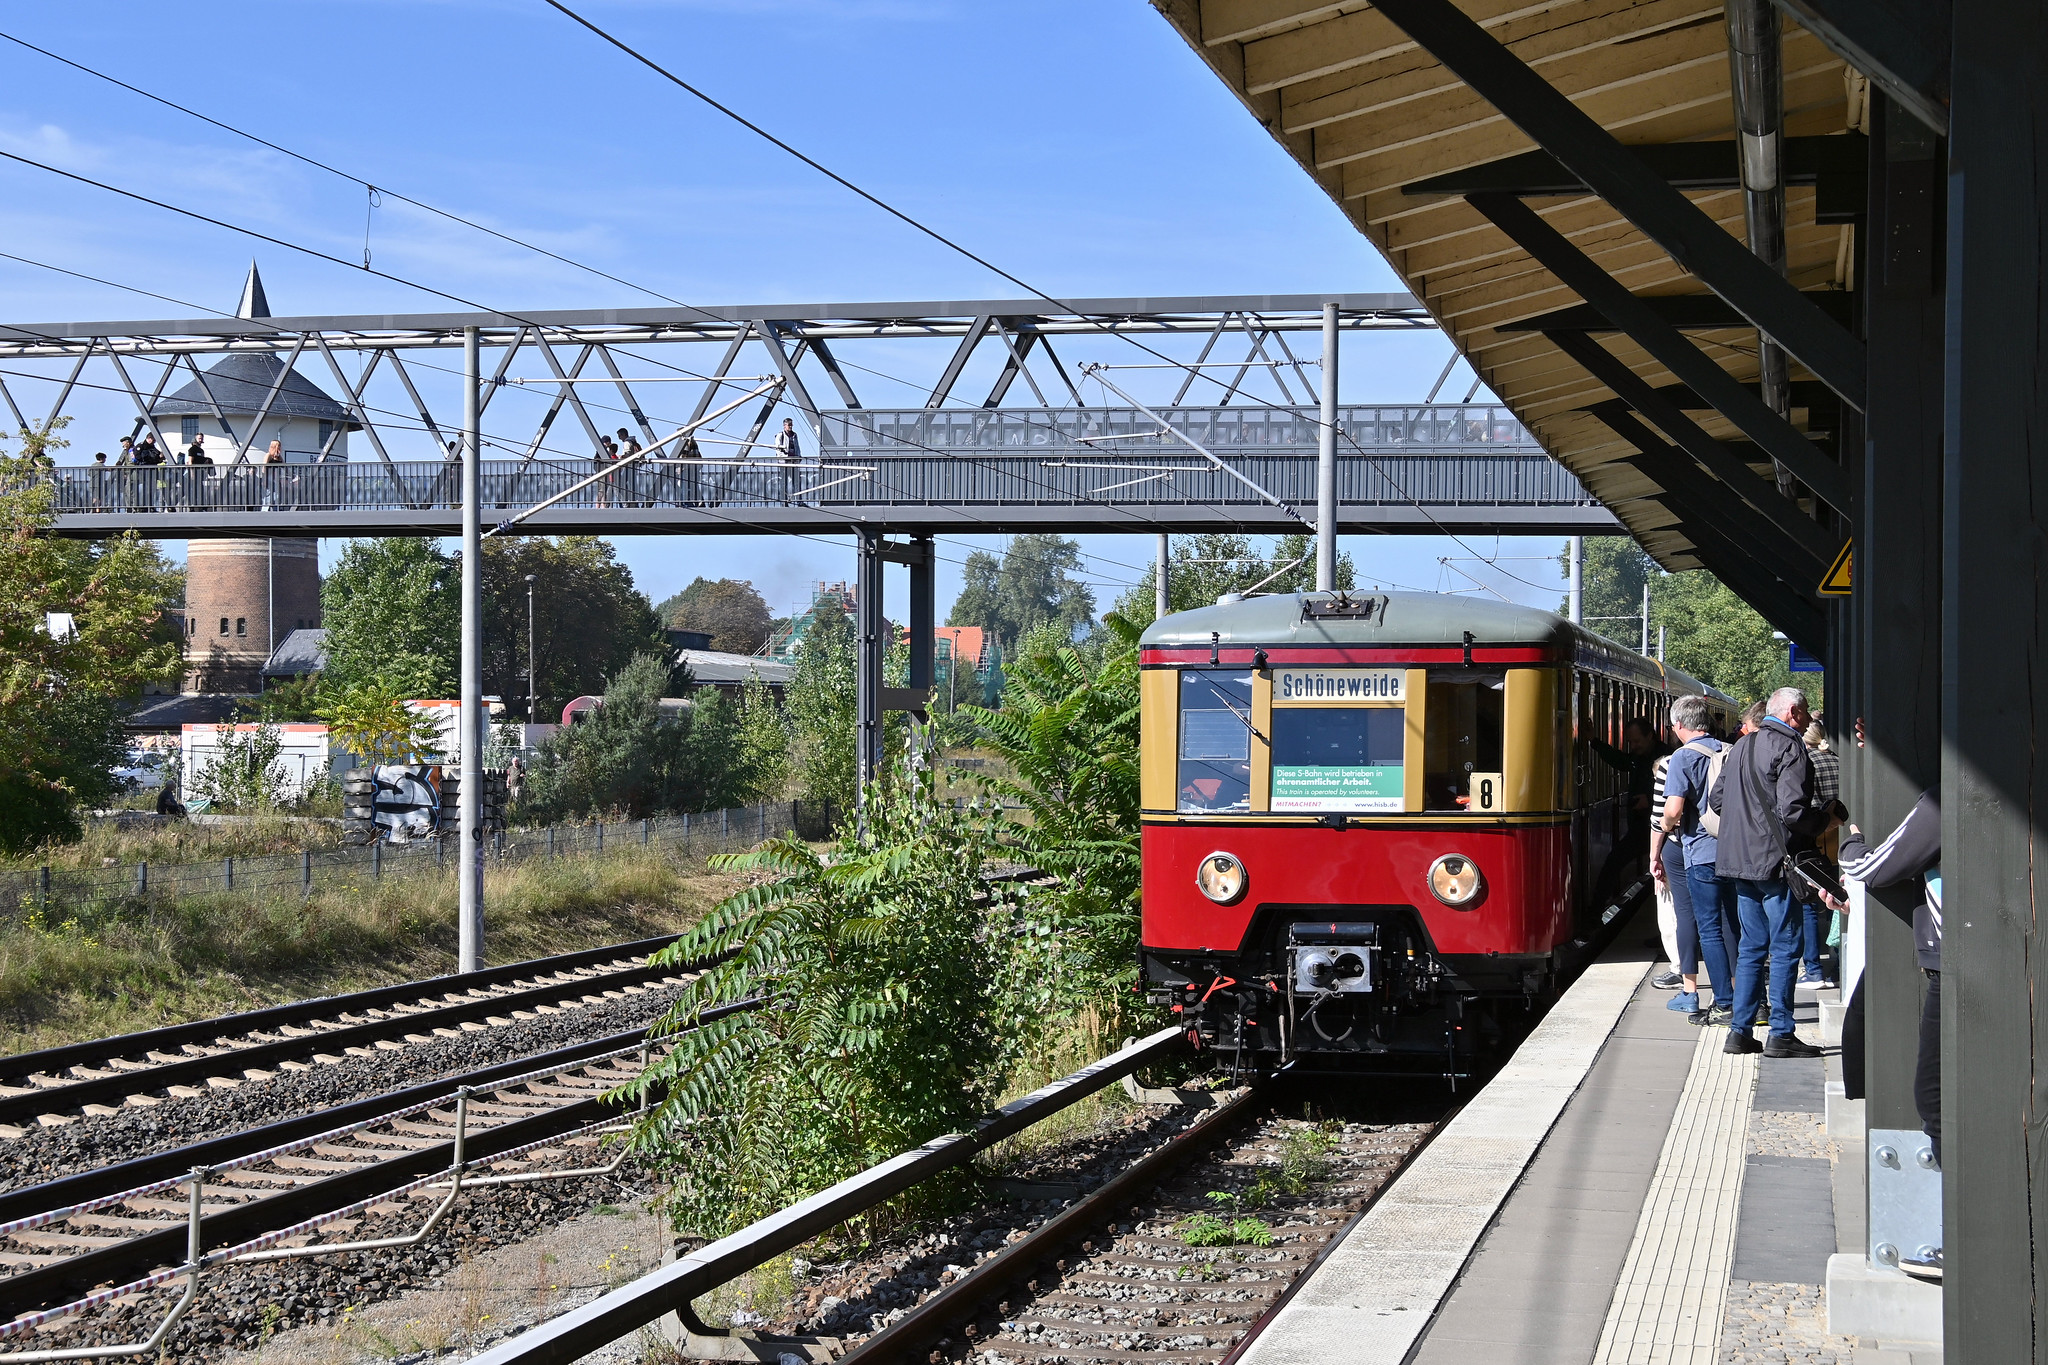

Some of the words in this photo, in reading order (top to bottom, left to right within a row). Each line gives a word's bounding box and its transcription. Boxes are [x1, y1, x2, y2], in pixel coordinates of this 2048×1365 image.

[1283, 673, 1399, 697] Schöneweide
[1297, 769, 1322, 777] S-Bahn
[1324, 769, 1340, 777] wird
[1341, 769, 1374, 777] betrieben
[1376, 769, 1383, 777] in
[1276, 778, 1340, 786] ehrenamtlicher
[1343, 778, 1372, 786] Arbeit.
[1311, 788, 1338, 796] operated
[1340, 788, 1347, 796] by
[1480, 779, 1493, 809] 8
